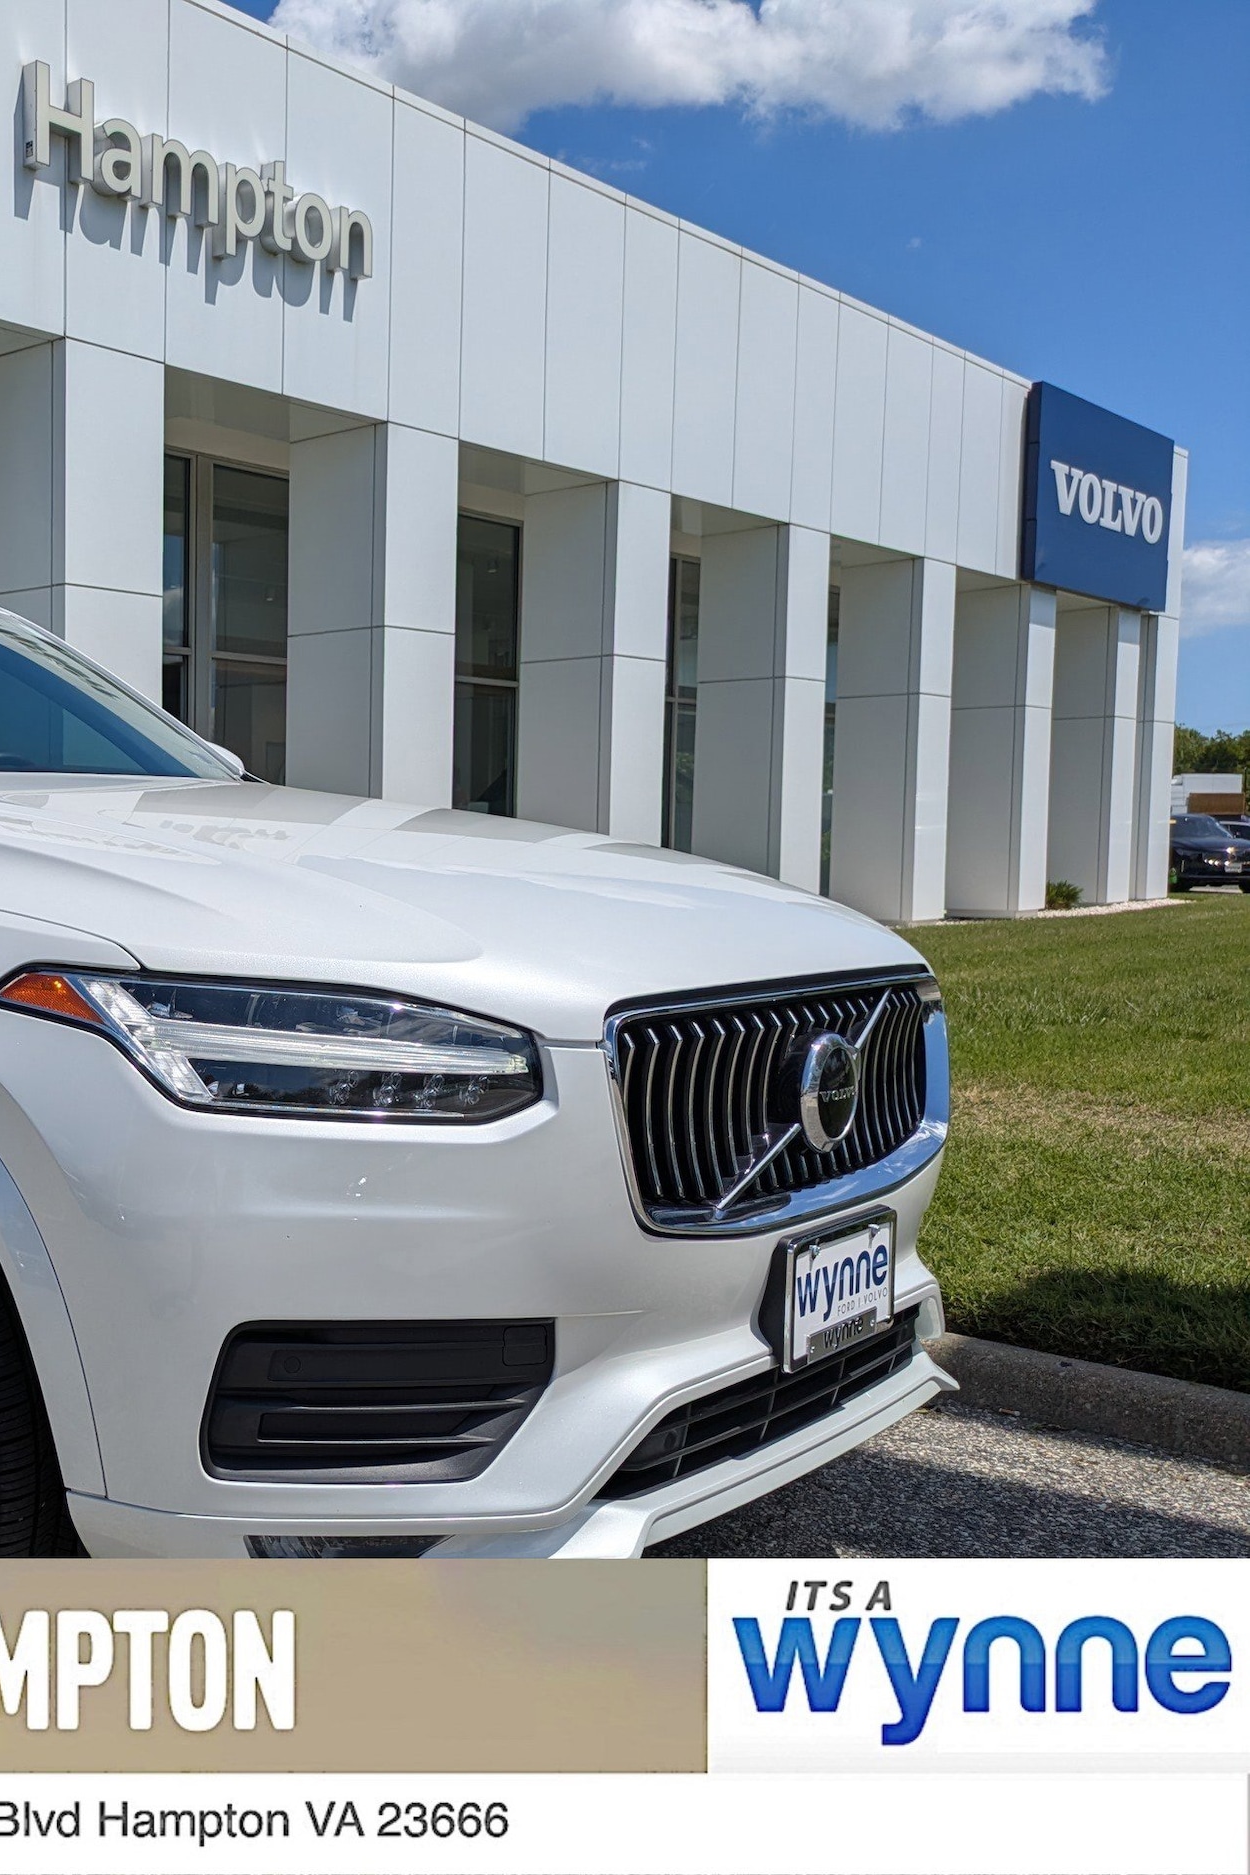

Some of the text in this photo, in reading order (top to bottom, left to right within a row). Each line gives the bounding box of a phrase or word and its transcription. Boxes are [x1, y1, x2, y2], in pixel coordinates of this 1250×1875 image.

[24, 60, 373, 280] Hampton
[1050, 459, 1163, 545] VOLVO
[796, 1244, 888, 1323] wynne
[837, 1286, 888, 1317] FORD VOLVO
[823, 1316, 864, 1350] wynne
